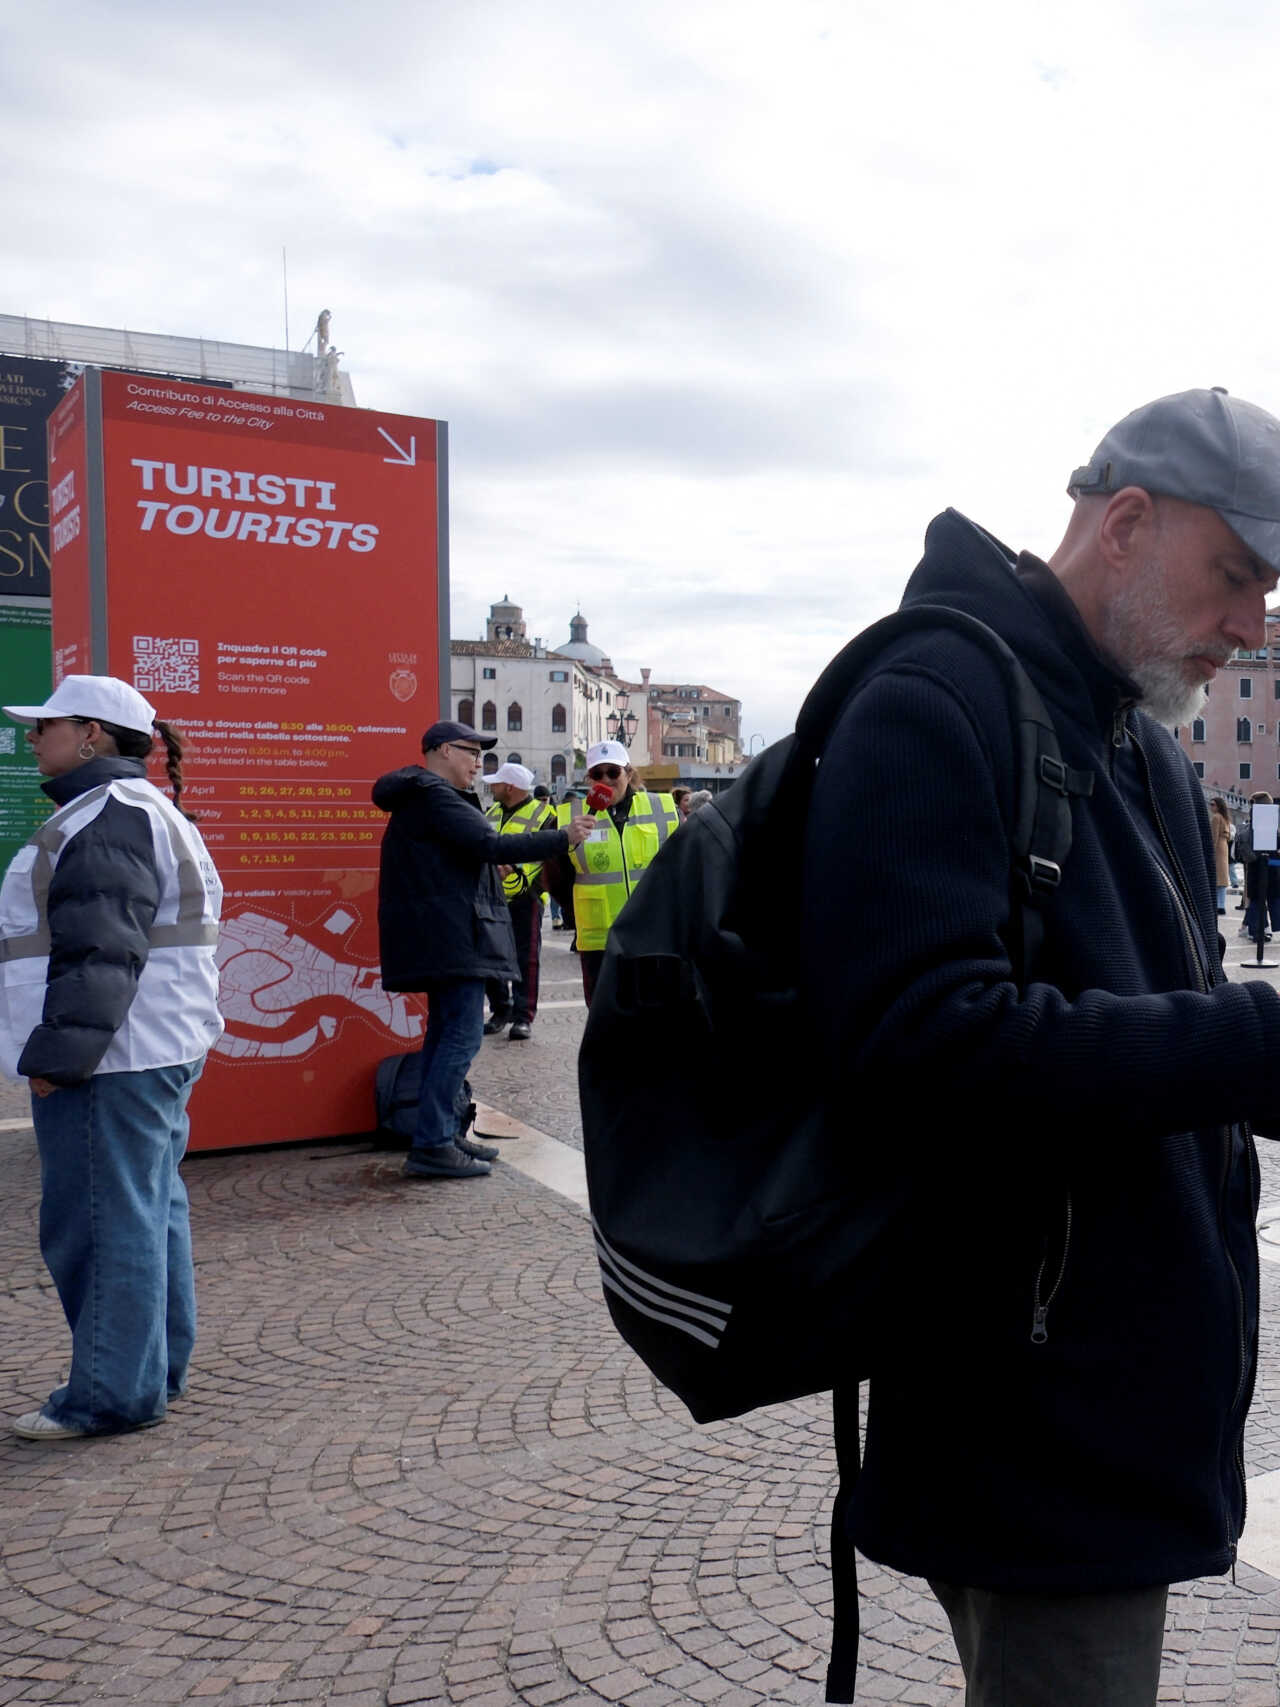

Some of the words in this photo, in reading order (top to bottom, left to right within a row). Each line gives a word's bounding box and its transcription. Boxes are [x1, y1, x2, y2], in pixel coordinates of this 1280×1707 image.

[127, 383, 200, 403] Contributo
[202, 394, 214, 405] di
[217, 397, 271, 414] Accesso
[273, 405, 294, 417] alla
[296, 408, 325, 421] Città
[126, 400, 178, 415] Access
[178, 407, 204, 419] Fee
[206, 412, 221, 421] to
[223, 414, 246, 425] the
[247, 417, 275, 430] City
[131, 458, 336, 511] TURISTI
[136, 500, 380, 553] TOURISTS
[217, 642, 270, 654] Inquadra
[272, 645, 278, 654] il
[281, 646, 297, 655] QR
[300, 648, 328, 657] code
[217, 655, 237, 664] per
[239, 656, 284, 666] saperne
[286, 658, 297, 667] di
[299, 659, 317, 669] più
[217, 671, 245, 681] Scan
[246, 673, 264, 682] the
[265, 674, 282, 683] QR
[284, 675, 310, 685] code
[218, 684, 230, 692] to
[231, 684, 258, 693] learn
[259, 686, 287, 695] more
[215, 720, 252, 729] dovuto
[254, 721, 278, 729] dalle
[357, 725, 407, 734] solamente
[188, 730, 227, 738] indicati
[229, 731, 254, 739] nella
[256, 732, 291, 740] tabella
[293, 734, 352, 742] sottostante.
[218, 757, 245, 765] listed
[191, 785, 215, 795] April
[199, 809, 222, 819] May
